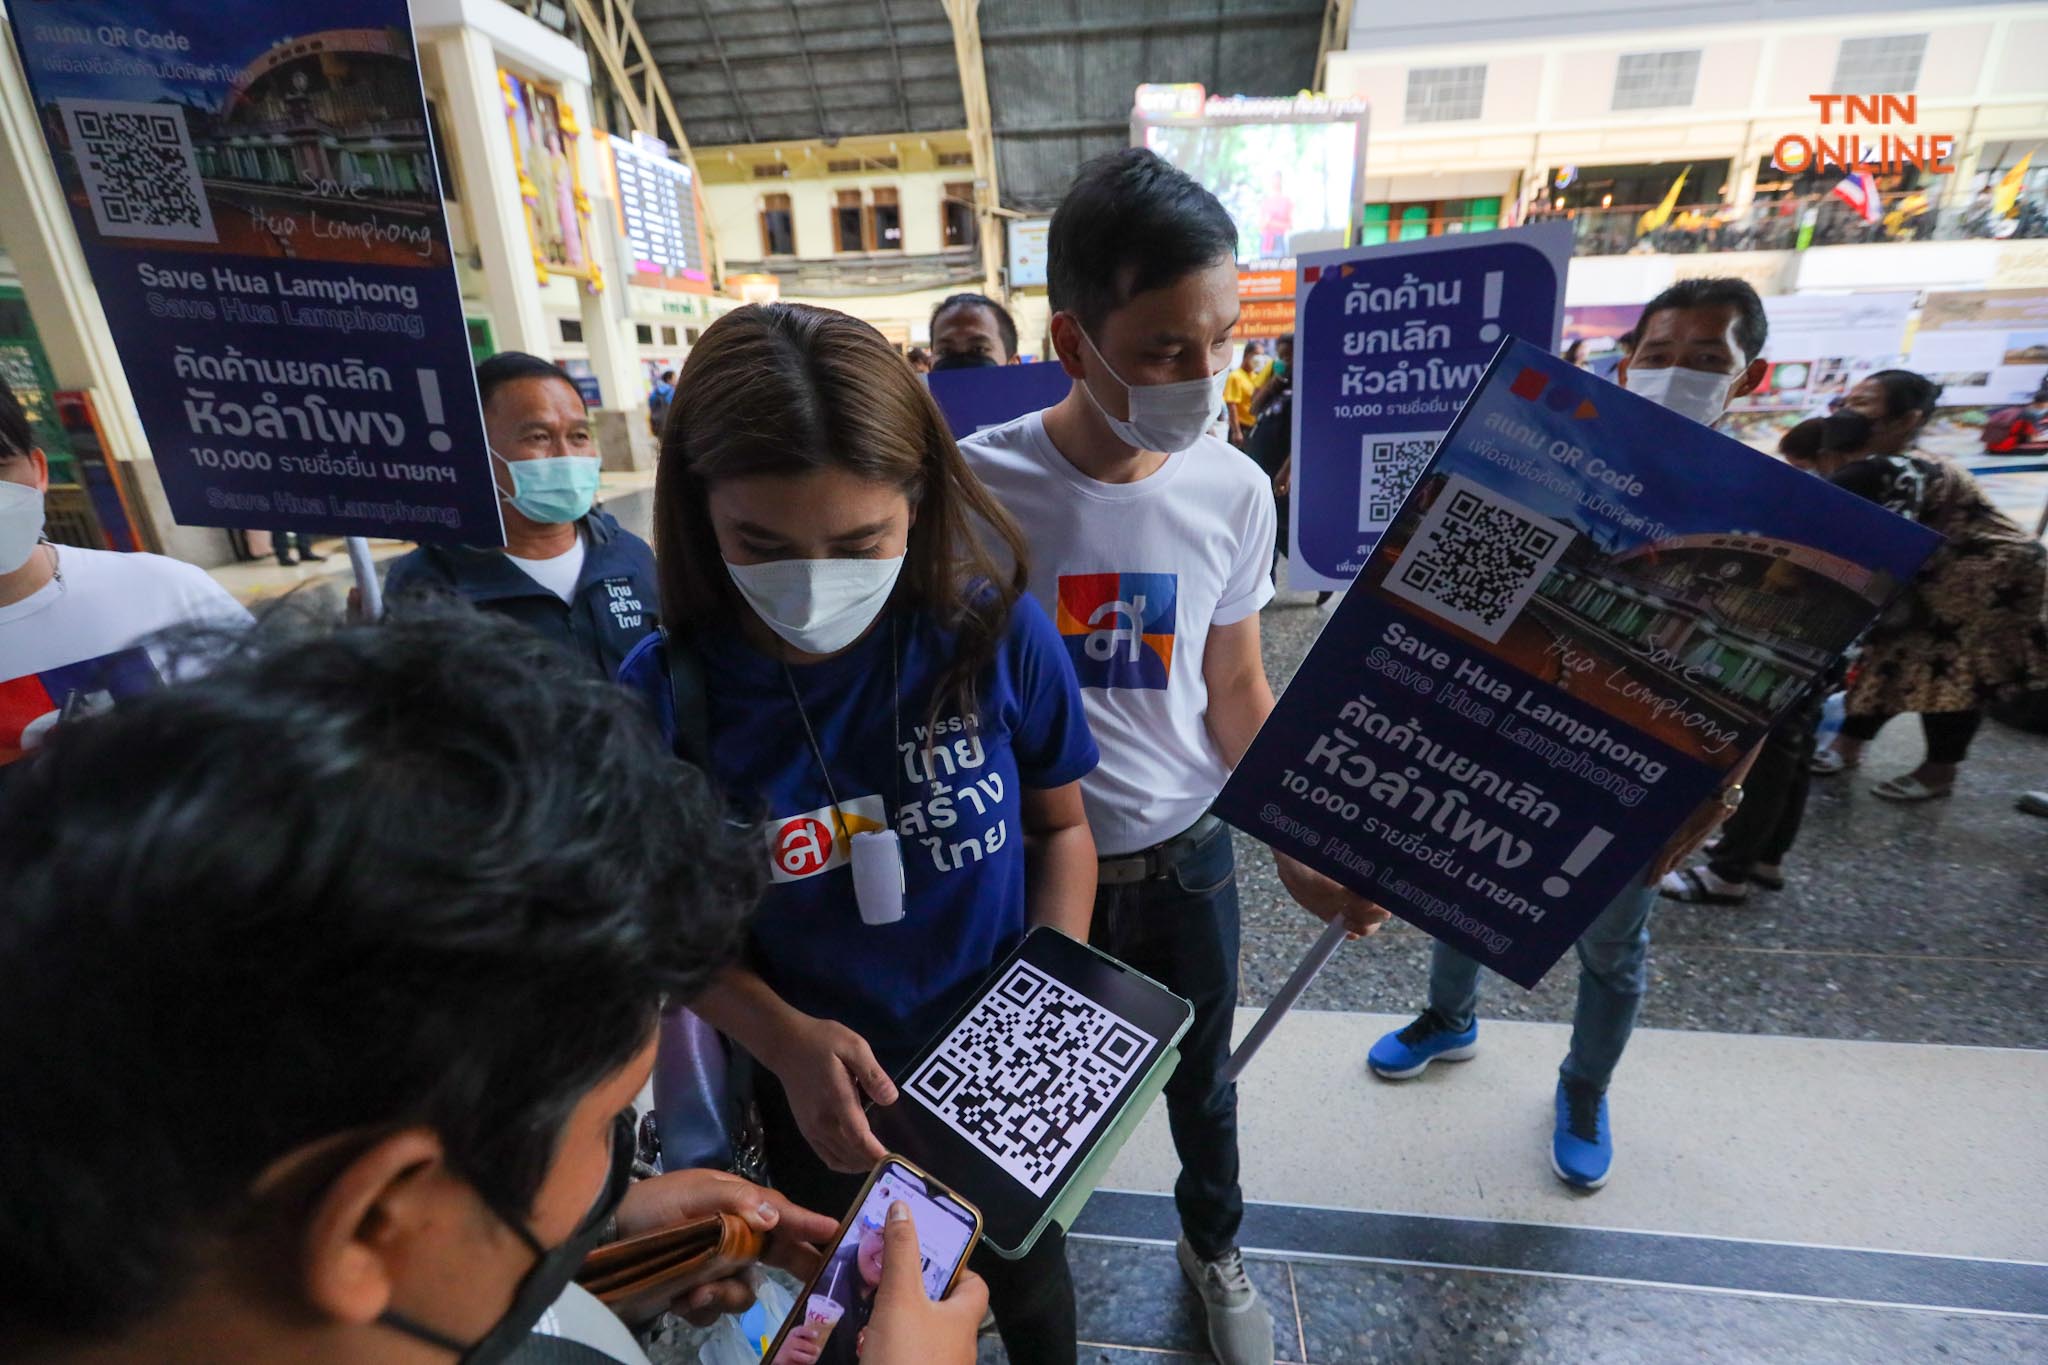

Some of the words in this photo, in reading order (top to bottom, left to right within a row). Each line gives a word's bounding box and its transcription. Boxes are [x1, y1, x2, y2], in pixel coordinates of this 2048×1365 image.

[97, 26, 130, 48] QR
[134, 29, 190, 51] Code
[300, 169, 366, 200] Save
[313, 214, 432, 257] Lamphong
[137, 263, 208, 290] Save
[215, 269, 270, 295] Hua
[276, 272, 420, 309] Lamphong
[1344, 272, 1462, 316] คัดค้าน
[1479, 271, 1504, 343] !
[146, 292, 217, 320] Save
[221, 298, 278, 326] Hua
[284, 301, 426, 339] Lamphong
[1343, 320, 1451, 355] ยกเลิก
[173, 345, 392, 392] คัดค้านยกเลิก
[183, 388, 407, 448] หัวลำโพง
[416, 367, 453, 453] !
[1334, 402, 1383, 418] 10,000
[190, 448, 272, 472] 10,000
[280, 450, 377, 478] รายชื่อยื่น
[383, 463, 457, 484] นายกฯ
[1484, 410, 1548, 449] สแกน
[1550, 440, 1585, 468] QR
[1585, 458, 1645, 498] Code
[206, 486, 270, 513] Save
[274, 491, 327, 515] Hua
[331, 494, 461, 529] Lamphong
[604, 583, 632, 598] ไทย
[609, 596, 642, 613] สร้าง
[615, 613, 641, 629] ไทย
[1631, 633, 1704, 684] Save
[1383, 622, 1450, 671] Save
[1455, 658, 1512, 703] Hua
[1515, 685, 1668, 784] Lamphong
[1543, 633, 1596, 673] Hua
[1605, 666, 1739, 754] Lamphong
[1366, 646, 1435, 695] Save
[1437, 681, 1495, 726] Hua
[1498, 713, 1648, 807] Lamphong
[898, 736, 985, 784] ไทย
[1338, 694, 1562, 829] คัดค้านยกเลิก
[895, 772, 1004, 836] สร้าง
[1304, 727, 1534, 870] หัวลำโพง
[1541, 824, 1616, 899] !
[919, 819, 1007, 872] ไทย
[1280, 768, 1360, 823] 10,000
[1363, 814, 1464, 879] รายชื่อยื่น
[1465, 870, 1547, 925] นายกฯ
[1259, 802, 1321, 847] Save
[1323, 835, 1375, 876] Hua
[1377, 866, 1513, 955] Lamphong
[807, 1310, 829, 1326] KFC
